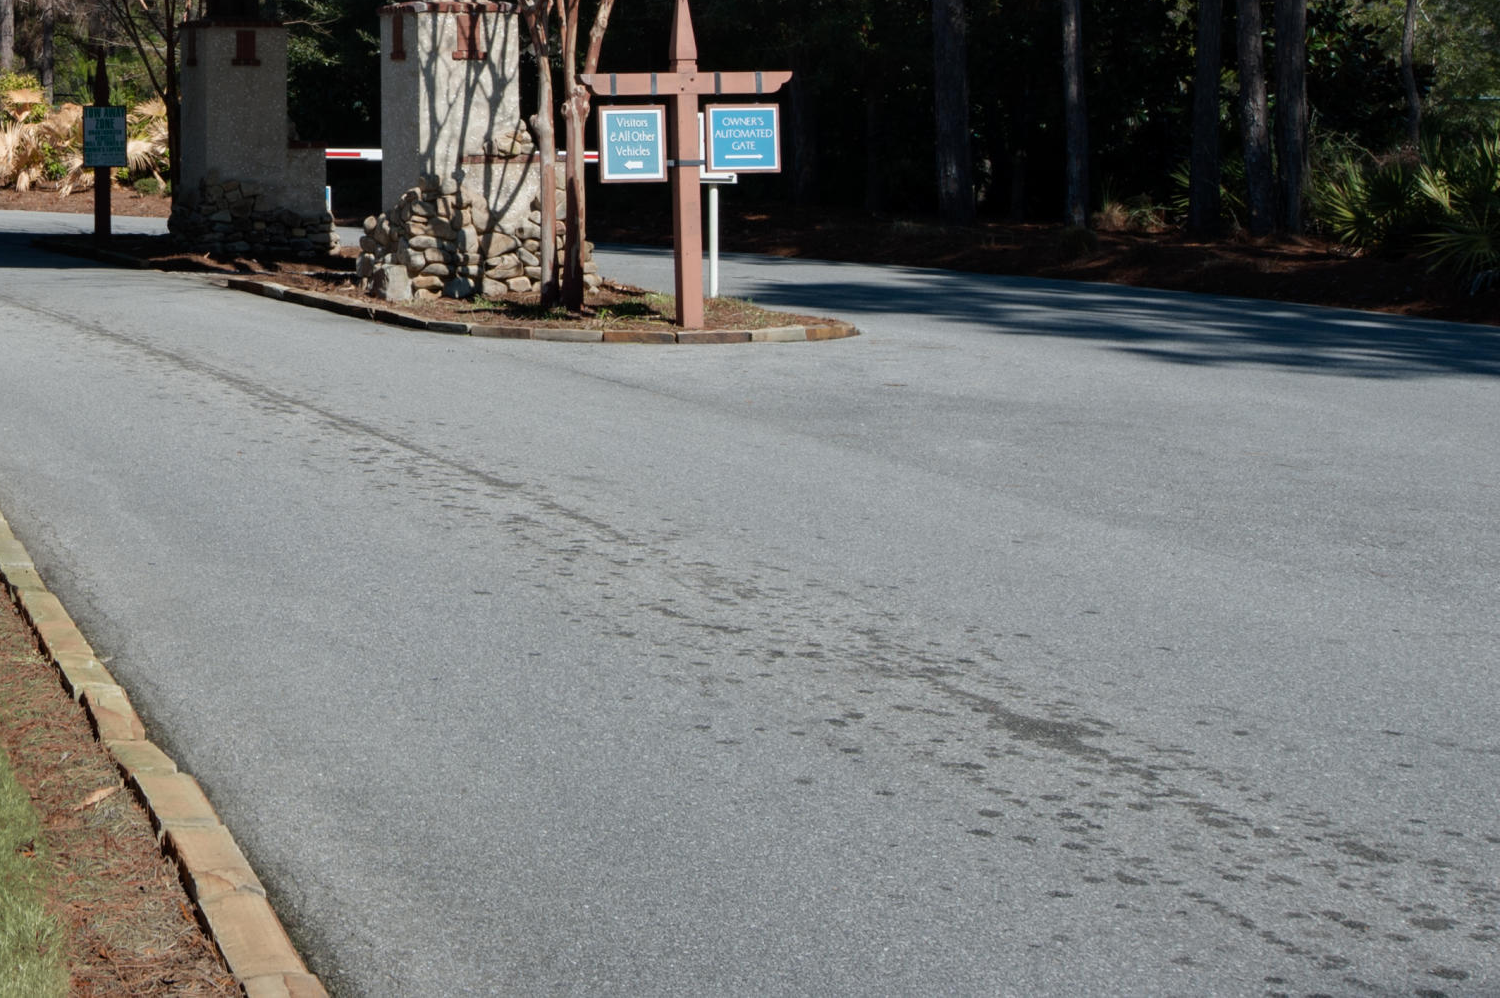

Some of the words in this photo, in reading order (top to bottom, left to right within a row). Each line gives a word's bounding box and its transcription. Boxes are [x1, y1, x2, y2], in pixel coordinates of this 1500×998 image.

[95, 118, 114, 129] ZONE
[616, 117, 648, 127] Visitors
[722, 116, 764, 126] OWNER'S
[618, 130, 630, 142] All
[631, 130, 655, 142] Other
[715, 128, 773, 138] AUTOMATED
[615, 145, 650, 156] Vehicles
[731, 141, 756, 151] GATE
